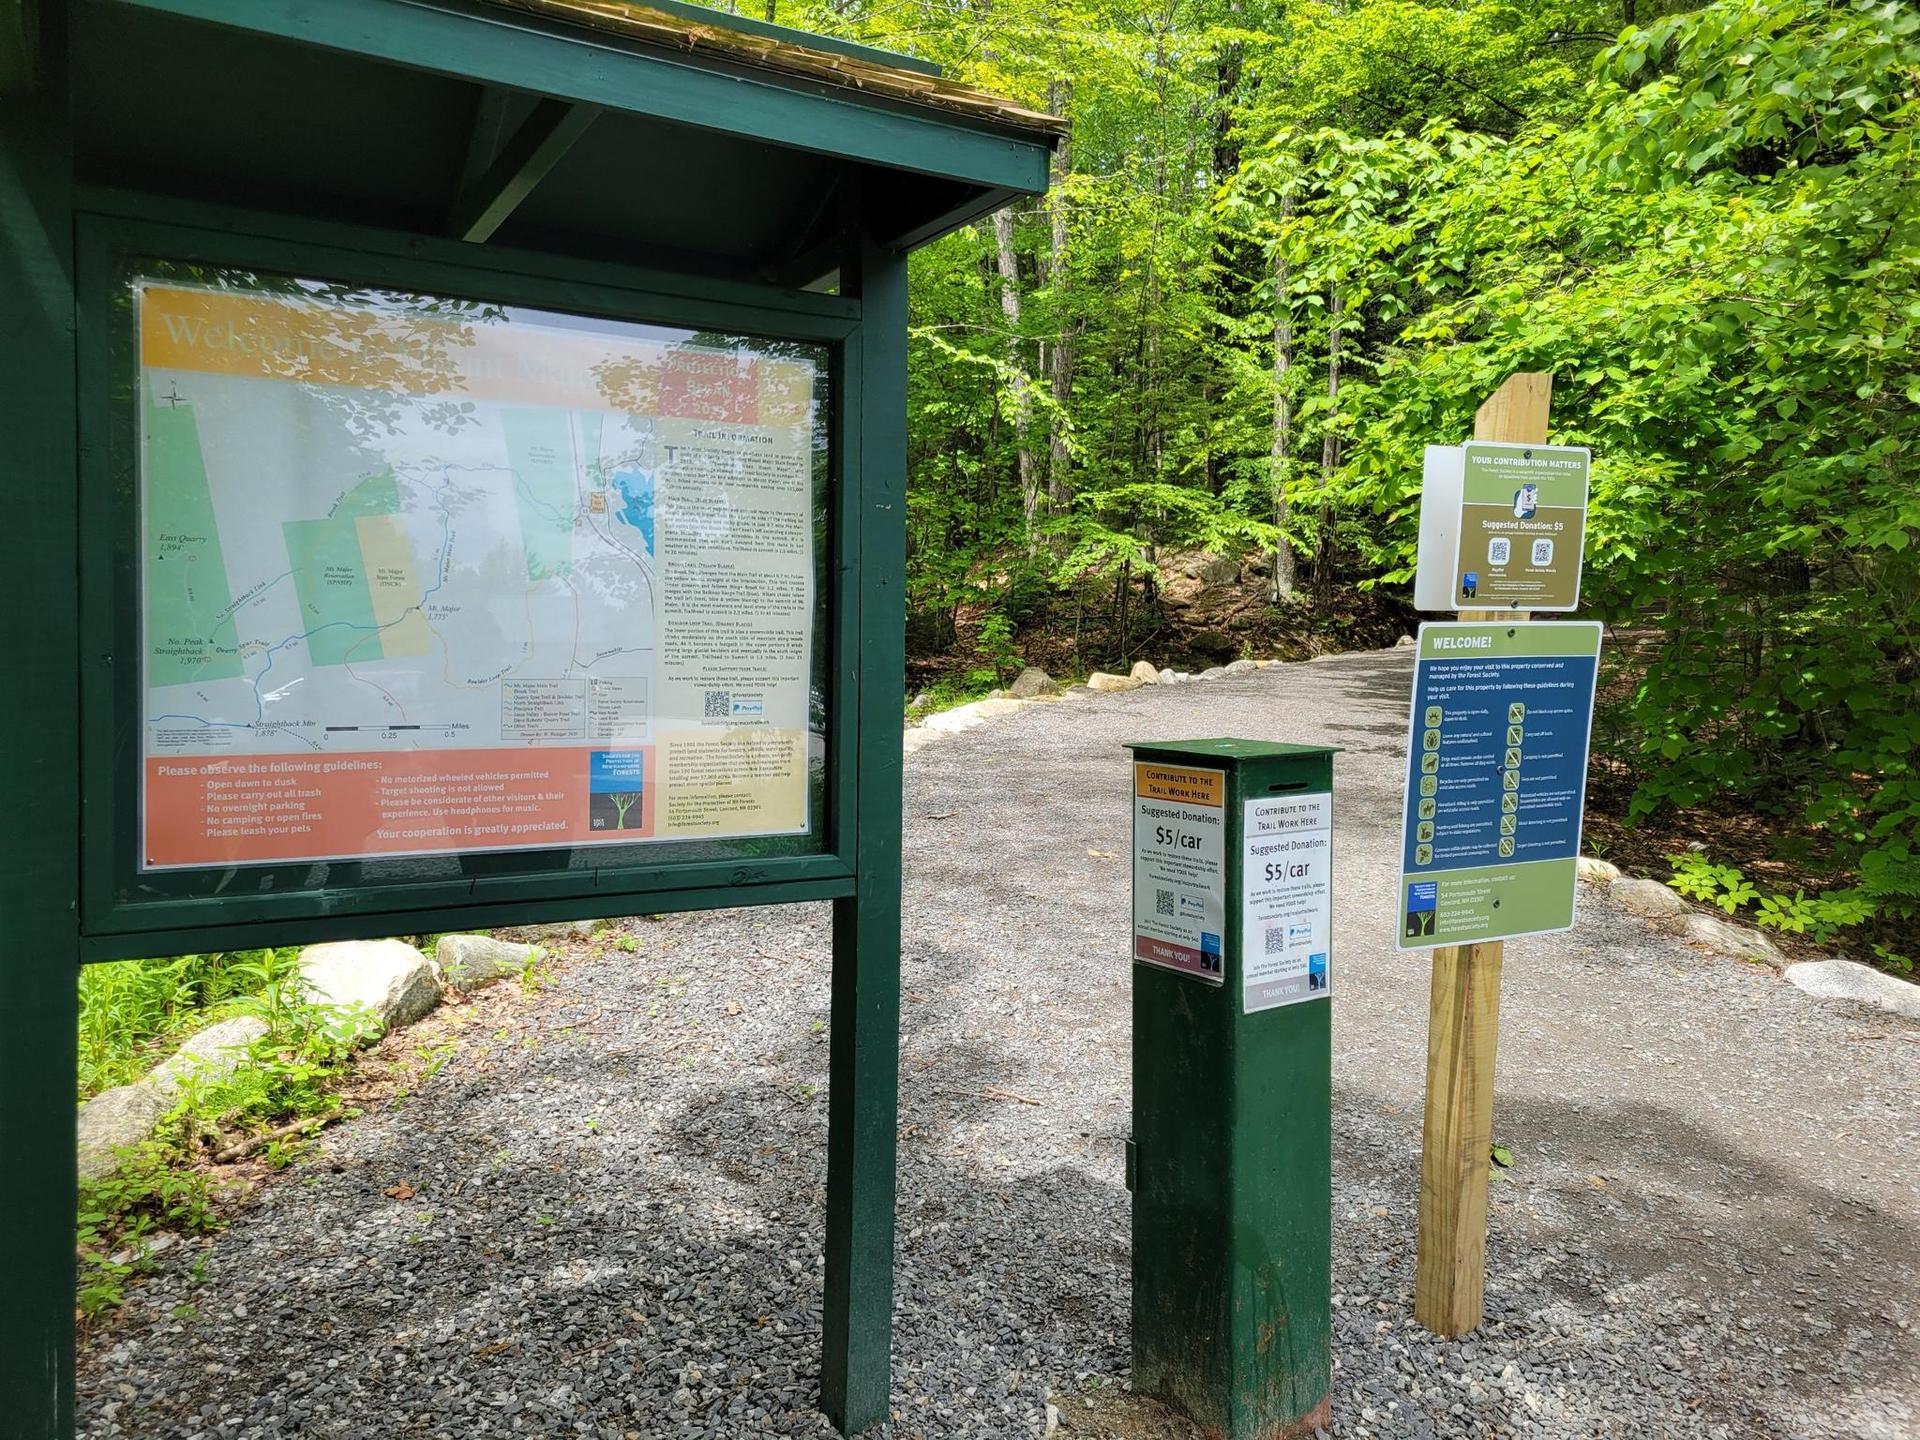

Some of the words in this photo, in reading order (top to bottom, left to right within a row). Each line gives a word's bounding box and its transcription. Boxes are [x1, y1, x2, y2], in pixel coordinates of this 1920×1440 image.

[1472, 455, 1492, 465] YOUR
[1494, 457, 1548, 468] CONTRIBUTION
[1550, 460, 1581, 470] MATTERS
[1482, 520, 1518, 530] Suggested
[1520, 521, 1553, 530] Donation:
[1554, 522, 1564, 531] $5
[1433, 636, 1492, 650] WELCOME!
[1474, 684, 1495, 692] property
[1536, 682, 1559, 690] guidelines
[451, 722, 470, 730] Miles
[381, 731, 398, 739] 0.25
[158, 766, 198, 776] Please
[200, 764, 246, 774] observe
[249, 763, 268, 774] the
[270, 762, 321, 773] following
[322, 760, 382, 772] guidelines:
[206, 780, 233, 790] Open
[234, 779, 260, 788] dawn
[262, 779, 272, 787] to
[274, 778, 297, 786] dusk
[380, 776, 393, 784] No
[394, 773, 437, 783] motorized
[439, 772, 474, 782] wheeled
[475, 772, 510, 780] vehicles
[510, 770, 549, 780] permitted
[1146, 770, 1187, 784] CONTRIBUTE
[1189, 776, 1198, 785] TO
[1199, 777, 1214, 787] THE
[206, 792, 239, 801] Please
[240, 792, 265, 801] carry
[284, 789, 296, 797] all
[297, 788, 321, 797] trash
[380, 787, 408, 797] Target
[409, 786, 447, 795] shooting
[448, 785, 456, 793] is
[473, 783, 505, 792] allowed
[1149, 784, 1167, 795] TRAIL
[1168, 786, 1190, 797] WORK
[1191, 789, 1210, 800] HERE
[380, 797, 410, 807] Please
[411, 798, 422, 806] be
[423, 795, 472, 805] considerate
[473, 794, 482, 803] of
[483, 794, 506, 802] other
[506, 792, 537, 801] visitors
[537, 793, 544, 801] &
[545, 791, 565, 801] their
[206, 804, 220, 813] No
[222, 803, 267, 813] overnight
[270, 801, 305, 811] parking
[382, 809, 431, 820] experience.
[432, 808, 449, 816] Use
[450, 805, 502, 816] headphones
[502, 804, 513, 813] for
[515, 803, 542, 812] music.
[1255, 805, 1297, 817] CONTRIBUTE
[1299, 804, 1307, 812] TO
[1308, 803, 1321, 811] THE
[206, 817, 220, 825] No
[222, 815, 264, 826] camping
[276, 813, 300, 823] open
[302, 811, 322, 820] fires
[1141, 804, 1181, 820] Suggested
[1182, 810, 1221, 826] Donation:
[206, 828, 239, 837] Please
[240, 826, 266, 835] leash
[268, 826, 289, 836] your
[291, 824, 311, 834] pets
[376, 829, 399, 839] Your
[401, 826, 462, 838] cooperation
[463, 825, 473, 834] is
[473, 823, 509, 836] greatly
[511, 820, 569, 834] appreciated.
[1257, 820, 1277, 831] TRAIL
[1277, 819, 1299, 829] WORK
[1301, 817, 1318, 826] HERE
[1156, 824, 1202, 850] $5/car
[1250, 841, 1290, 857] Suggested
[1291, 838, 1328, 851] Donation:
[1265, 860, 1310, 883] $5/car
[1152, 945, 1174, 957] THANK
[1173, 951, 1191, 963] YOU!
[1263, 986, 1284, 999] THANK
[1284, 983, 1300, 994] YOU!
